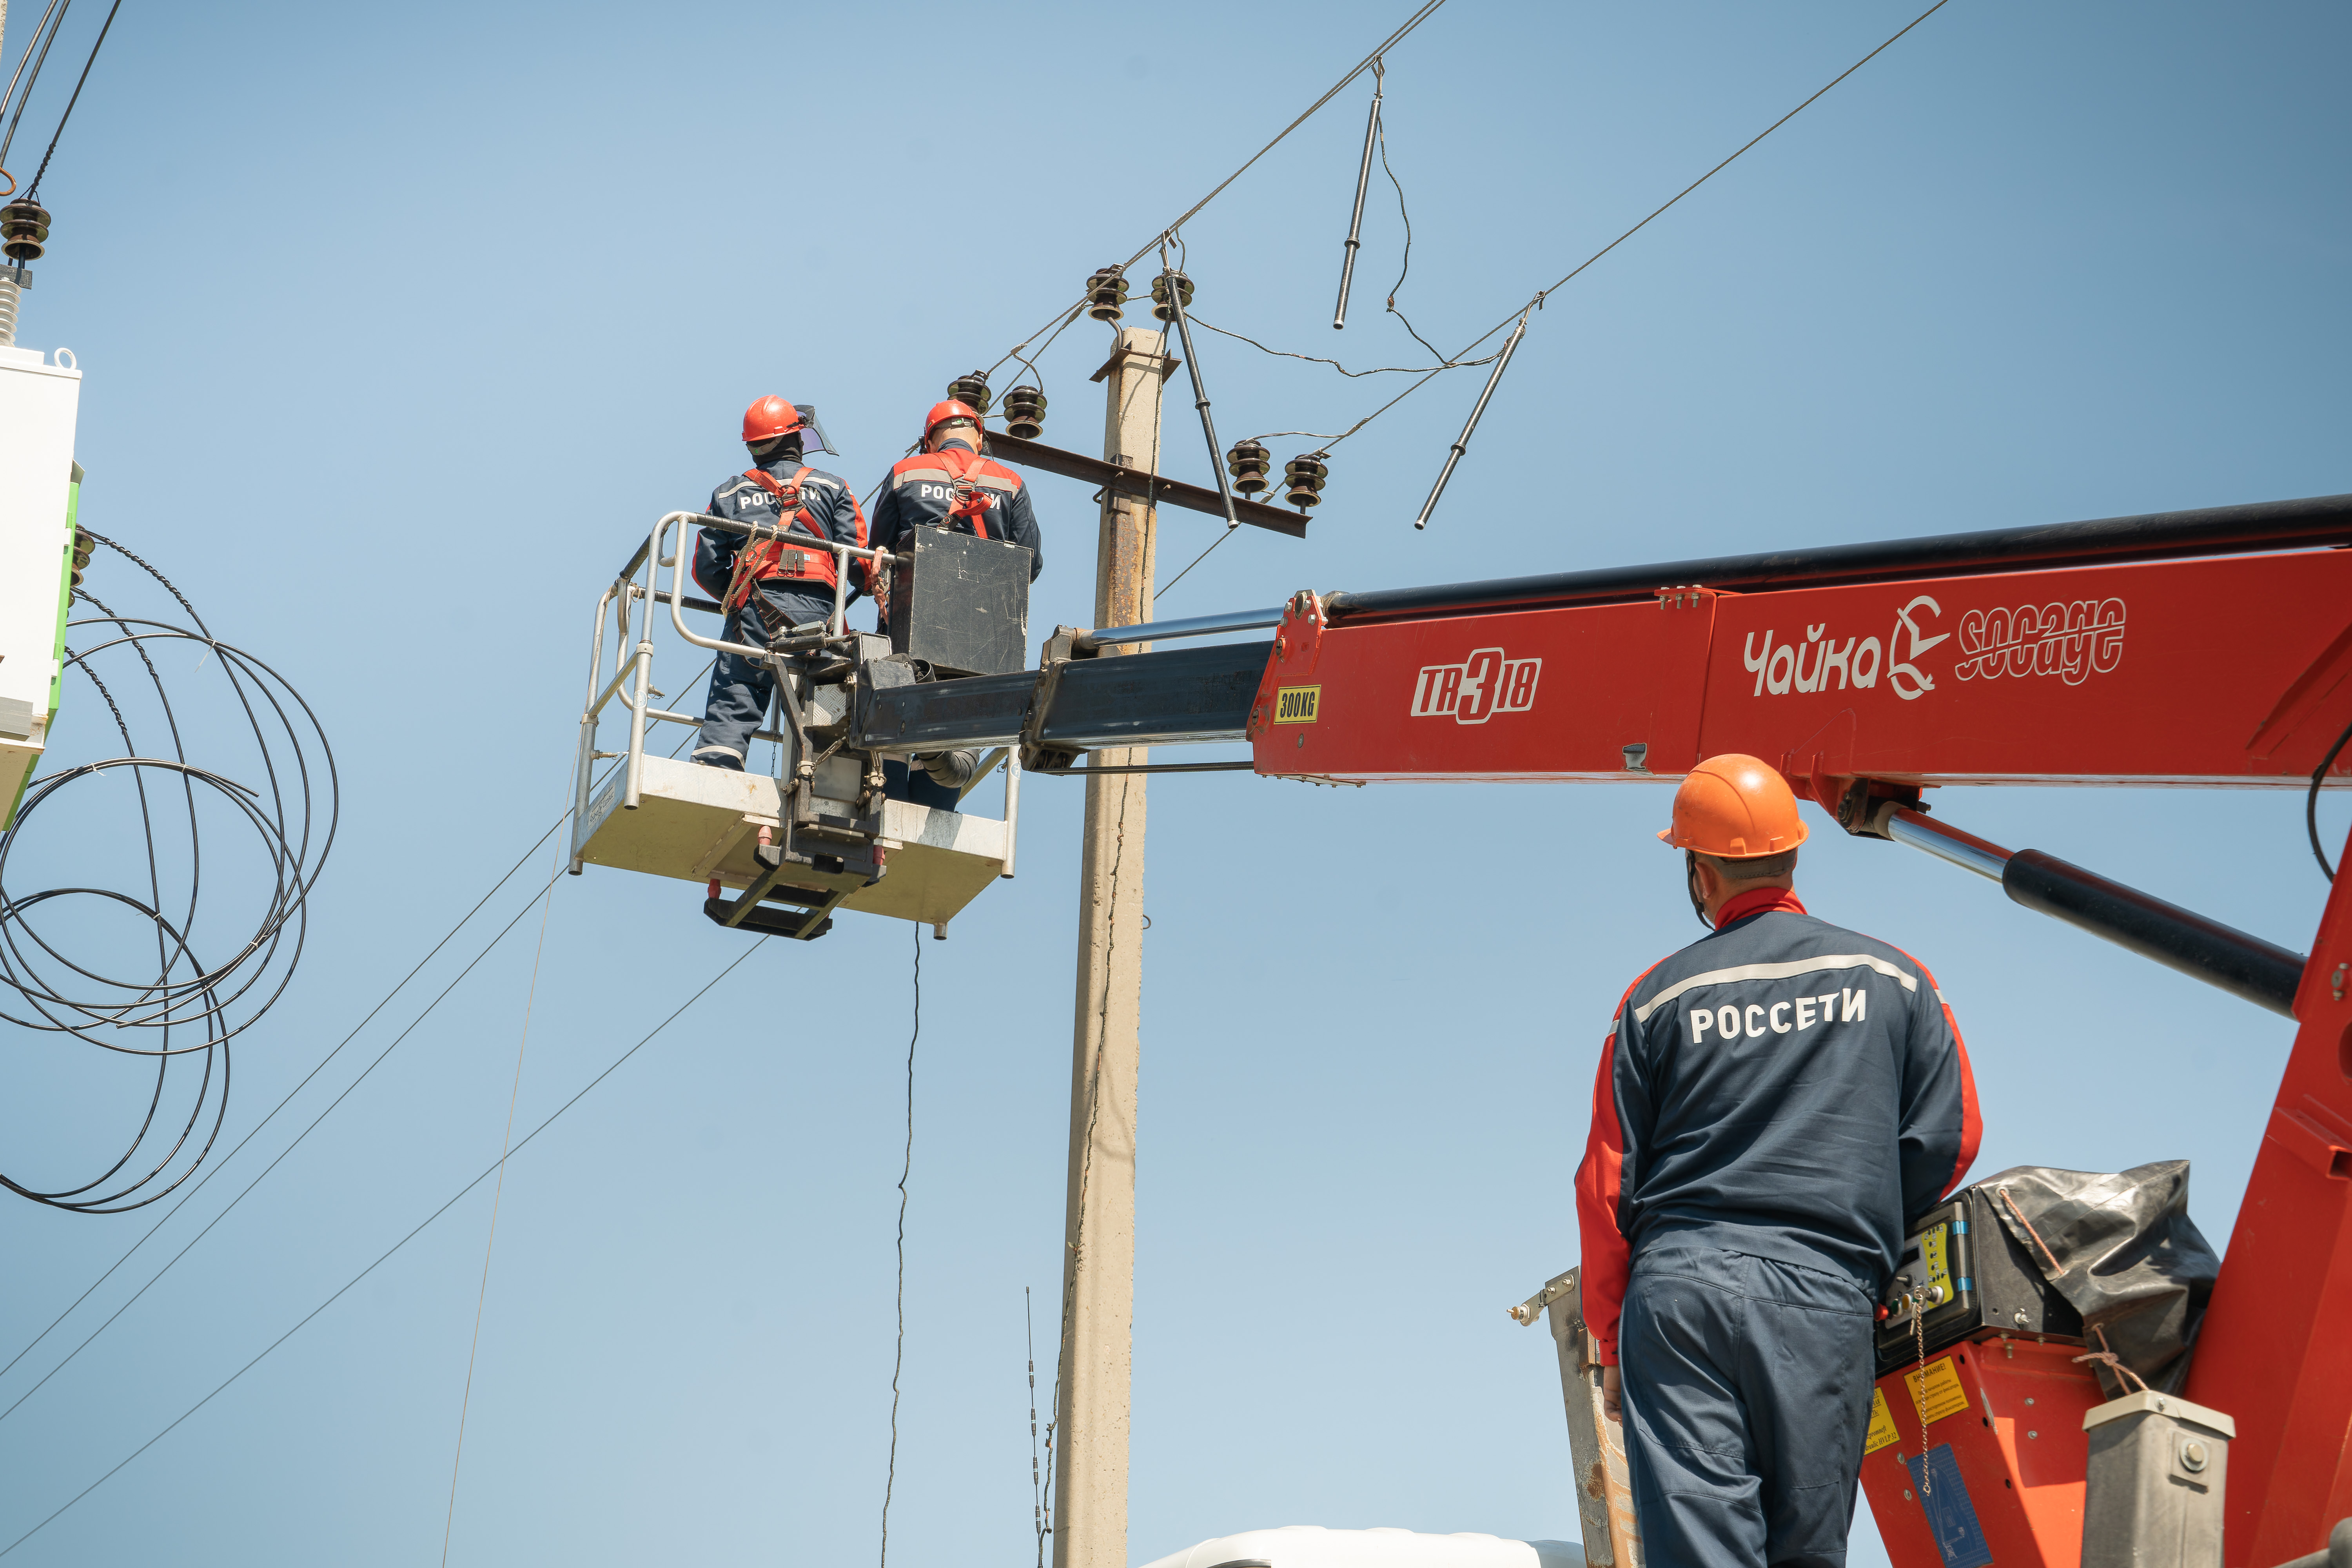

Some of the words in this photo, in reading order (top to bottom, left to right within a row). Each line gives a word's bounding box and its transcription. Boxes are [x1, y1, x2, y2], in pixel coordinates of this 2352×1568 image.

[740, 486, 821, 510] РОСТИ
[921, 484, 1001, 510] РОСИ
[1743, 623, 1882, 697] Чайка
[1417, 651, 1538, 721] TR318
[1280, 691, 1315, 718] 300KG
[1690, 988, 1866, 1044] РОССЕТИ
[1913, 1363, 1946, 1383] ВНМАНИЕ!
[1865, 1441, 1878, 1451] draulic
[1878, 1434, 1891, 1445] HVLP
